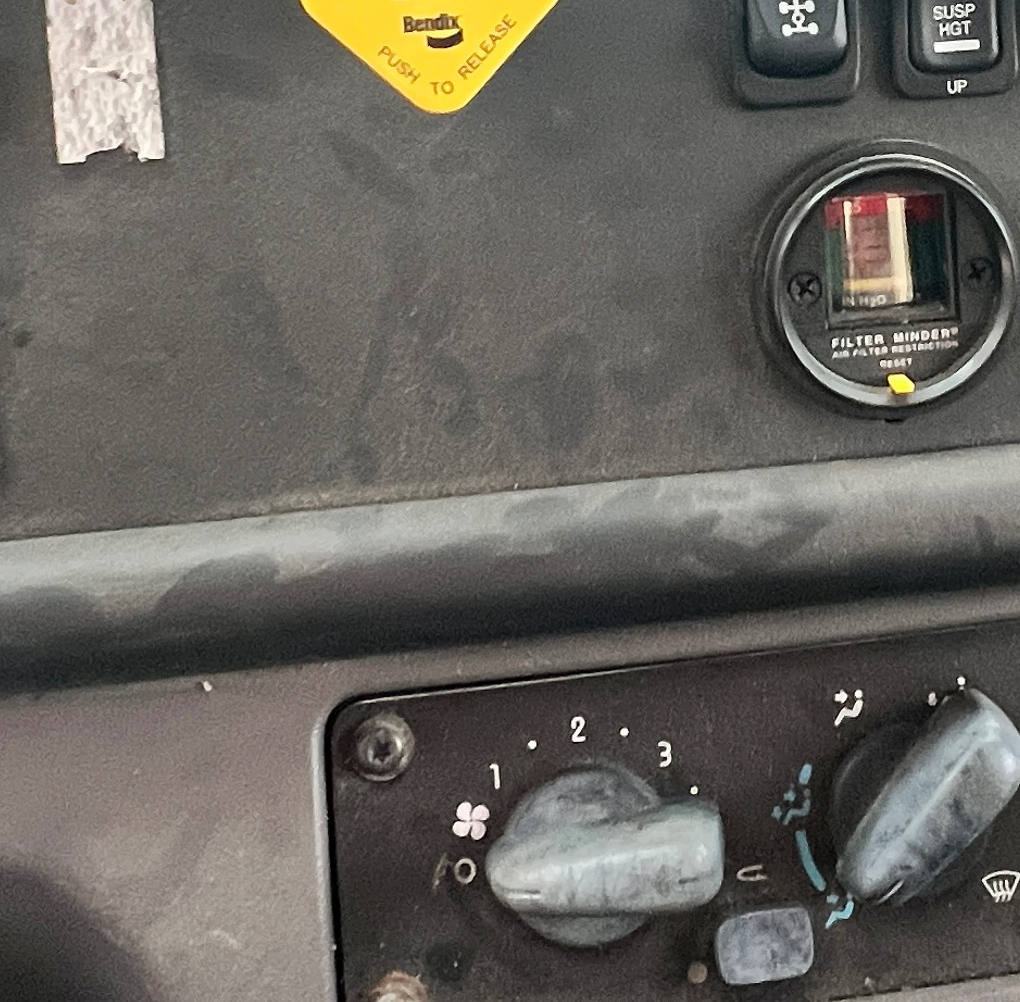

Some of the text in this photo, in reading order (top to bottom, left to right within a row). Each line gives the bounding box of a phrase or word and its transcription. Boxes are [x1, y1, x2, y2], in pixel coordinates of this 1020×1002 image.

[932, 3, 976, 21] SUSP
[403, 13, 463, 34] Bendix
[938, 20, 972, 37] HGT
[377, 14, 518, 96] PUSH TO RELEASE
[946, 79, 968, 94] UP
[831, 334, 885, 349] FILTER
[852, 345, 888, 357] FILTER
[571, 716, 587, 743] 2
[658, 741, 672, 768] 3
[489, 763, 501, 790] 1
